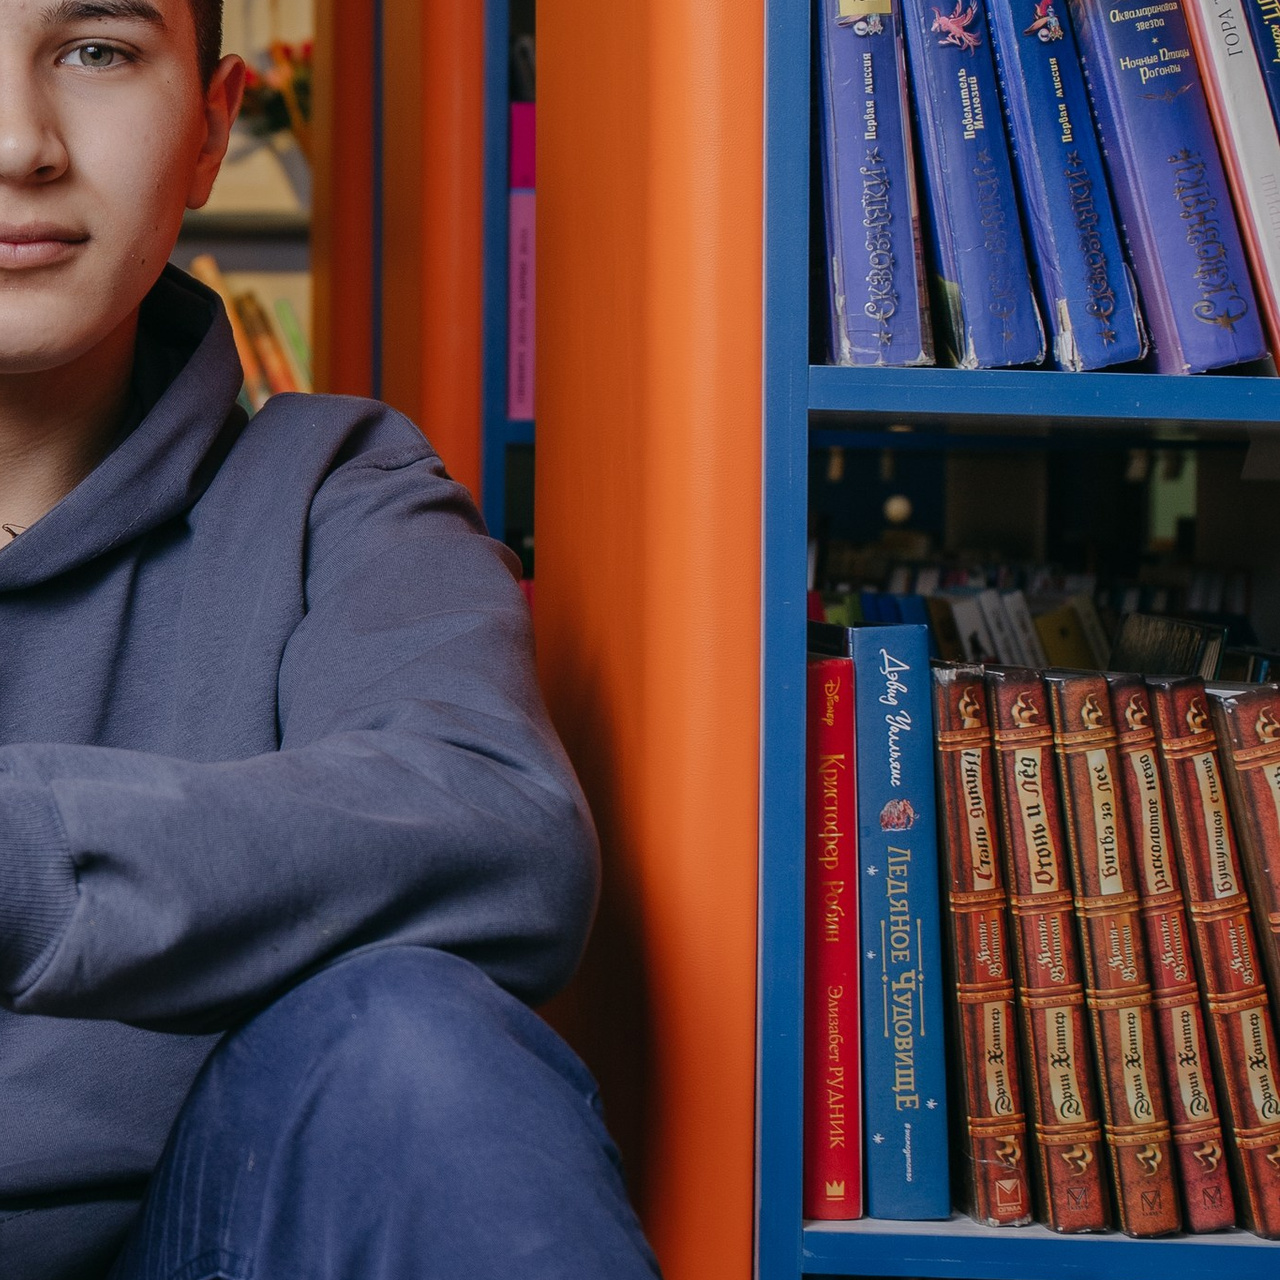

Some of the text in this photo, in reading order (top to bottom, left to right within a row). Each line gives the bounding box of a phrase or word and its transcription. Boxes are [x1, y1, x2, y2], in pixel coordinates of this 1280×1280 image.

[1109, 1, 1178, 23] Аквамариновая
[1135, 17, 1165, 32] звезда
[1220, 9, 1244, 57] ГОРА
[1119, 47, 1191, 71] Ночные Птицы
[1139, 62, 1182, 85] Рогонды
[862, 52, 877, 140] Первая миссия
[957, 67, 976, 140] Повелитель
[967, 76, 985, 130] Иллюзий
[1048, 57, 1074, 143] Первая миссия
[822, 676, 841, 727] Disney
[879, 648, 912, 787] Дэвид Уолльямс
[1025, 803, 1042, 820] и
[1100, 801, 1114, 820] за
[1139, 754, 1171, 892] Расколотое небо
[1202, 757, 1234, 895] Бушующая стихия
[818, 754, 846, 942] Кристофер Робин
[973, 825, 994, 882] Стань
[1031, 822, 1055, 886] Огонь
[1099, 825, 1119, 880] Битва
[976, 914, 992, 967] Коты-
[988, 919, 1004, 978] Воители
[1037, 914, 1054, 970] Коты-
[1050, 916, 1066, 984] Воители
[1108, 921, 1125, 971] Коты-
[1121, 925, 1138, 982] Воители
[1161, 914, 1178, 970] Коты-
[1172, 916, 1189, 982] Воители
[1228, 920, 1247, 974] Коты-
[1238, 924, 1256, 985] Воители
[885, 846, 920, 1111] ЛЕДЯНОЕ ЧУДОВИЩЕ
[826, 985, 846, 1149] Элизабет РУДНИК
[988, 1007, 1012, 1115] Эрин Хантер
[1051, 1011, 1082, 1119] Эрин Хантер
[1125, 1012, 1152, 1119] Эрин Хантер
[1179, 1010, 1210, 1117] Эрин Хантер
[1250, 1012, 1280, 1119] Эрин Хантер
